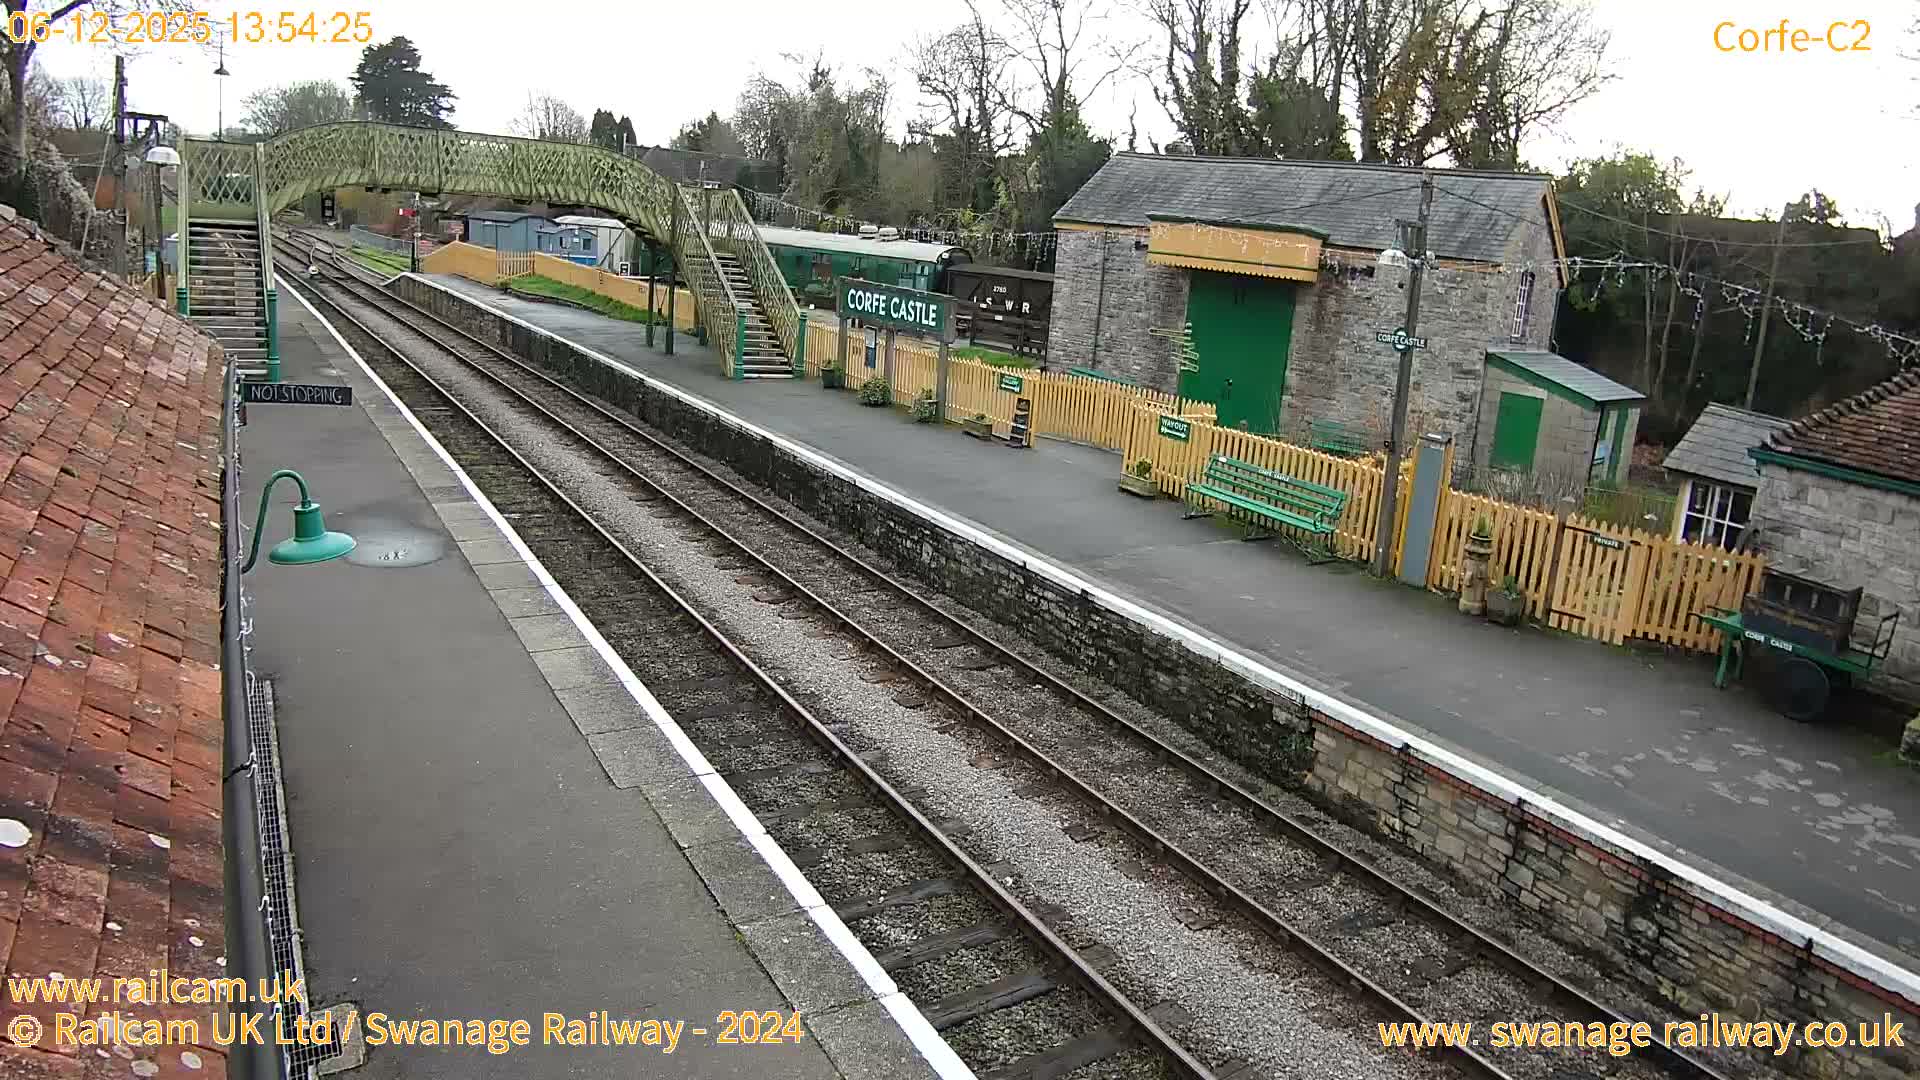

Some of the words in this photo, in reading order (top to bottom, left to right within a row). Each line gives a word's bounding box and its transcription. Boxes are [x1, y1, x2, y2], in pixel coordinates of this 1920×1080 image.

[848, 288, 886, 316] CORFE
[890, 297, 937, 327] CASTLE
[1378, 333, 1399, 344] CORFE
[1400, 336, 1425, 348] CASTLE
[251, 385, 278, 400] NOT
[279, 385, 342, 403] STOPPING
[1161, 418, 1175, 428] WAY
[1174, 422, 1188, 431] OUT
